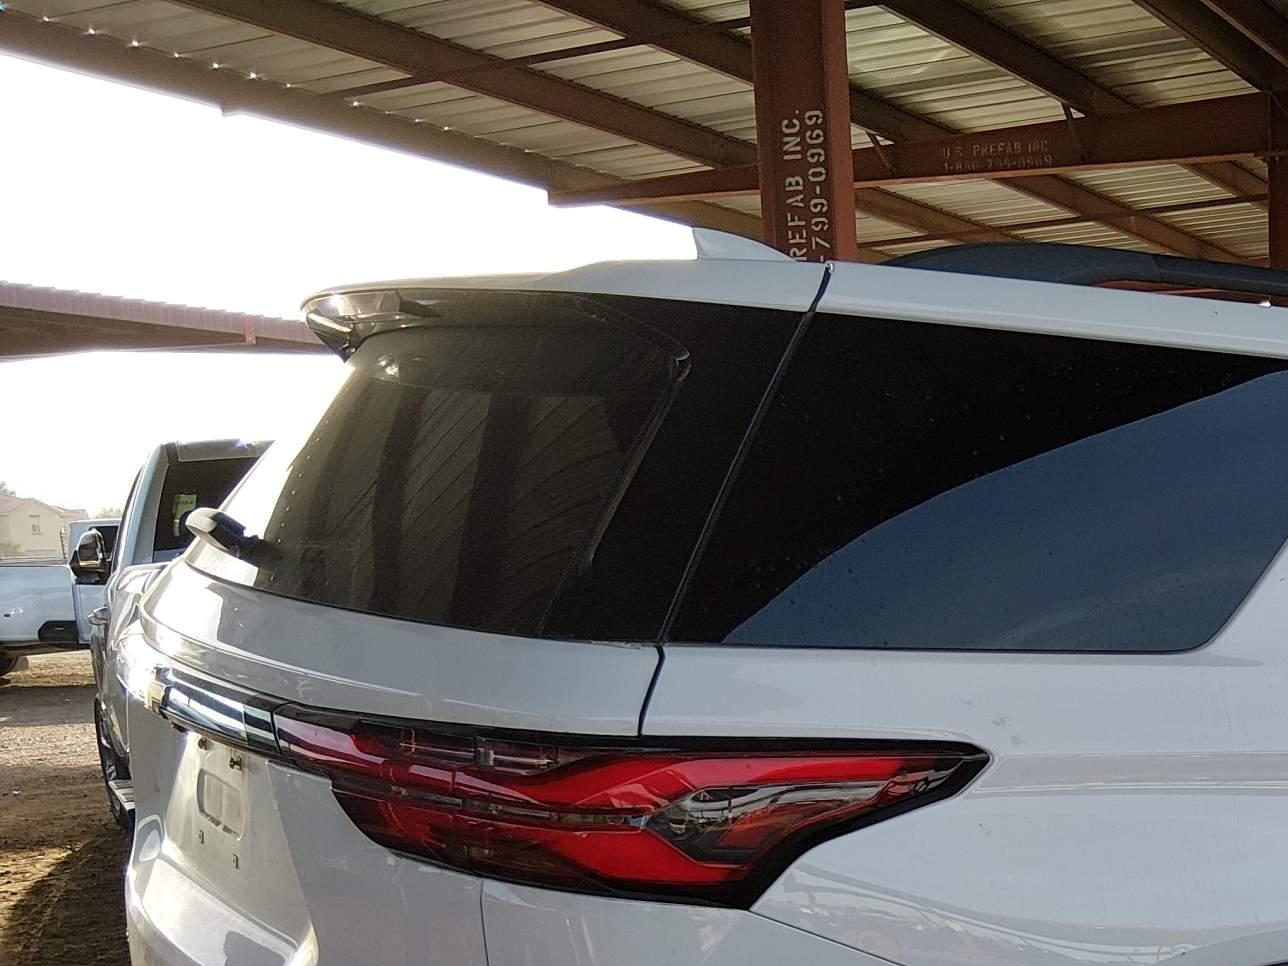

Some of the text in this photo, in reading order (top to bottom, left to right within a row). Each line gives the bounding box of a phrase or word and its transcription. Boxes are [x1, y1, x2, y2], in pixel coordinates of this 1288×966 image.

[781, 109, 808, 262] REFAB INC.
[804, 110, 831, 262] -799-0969
